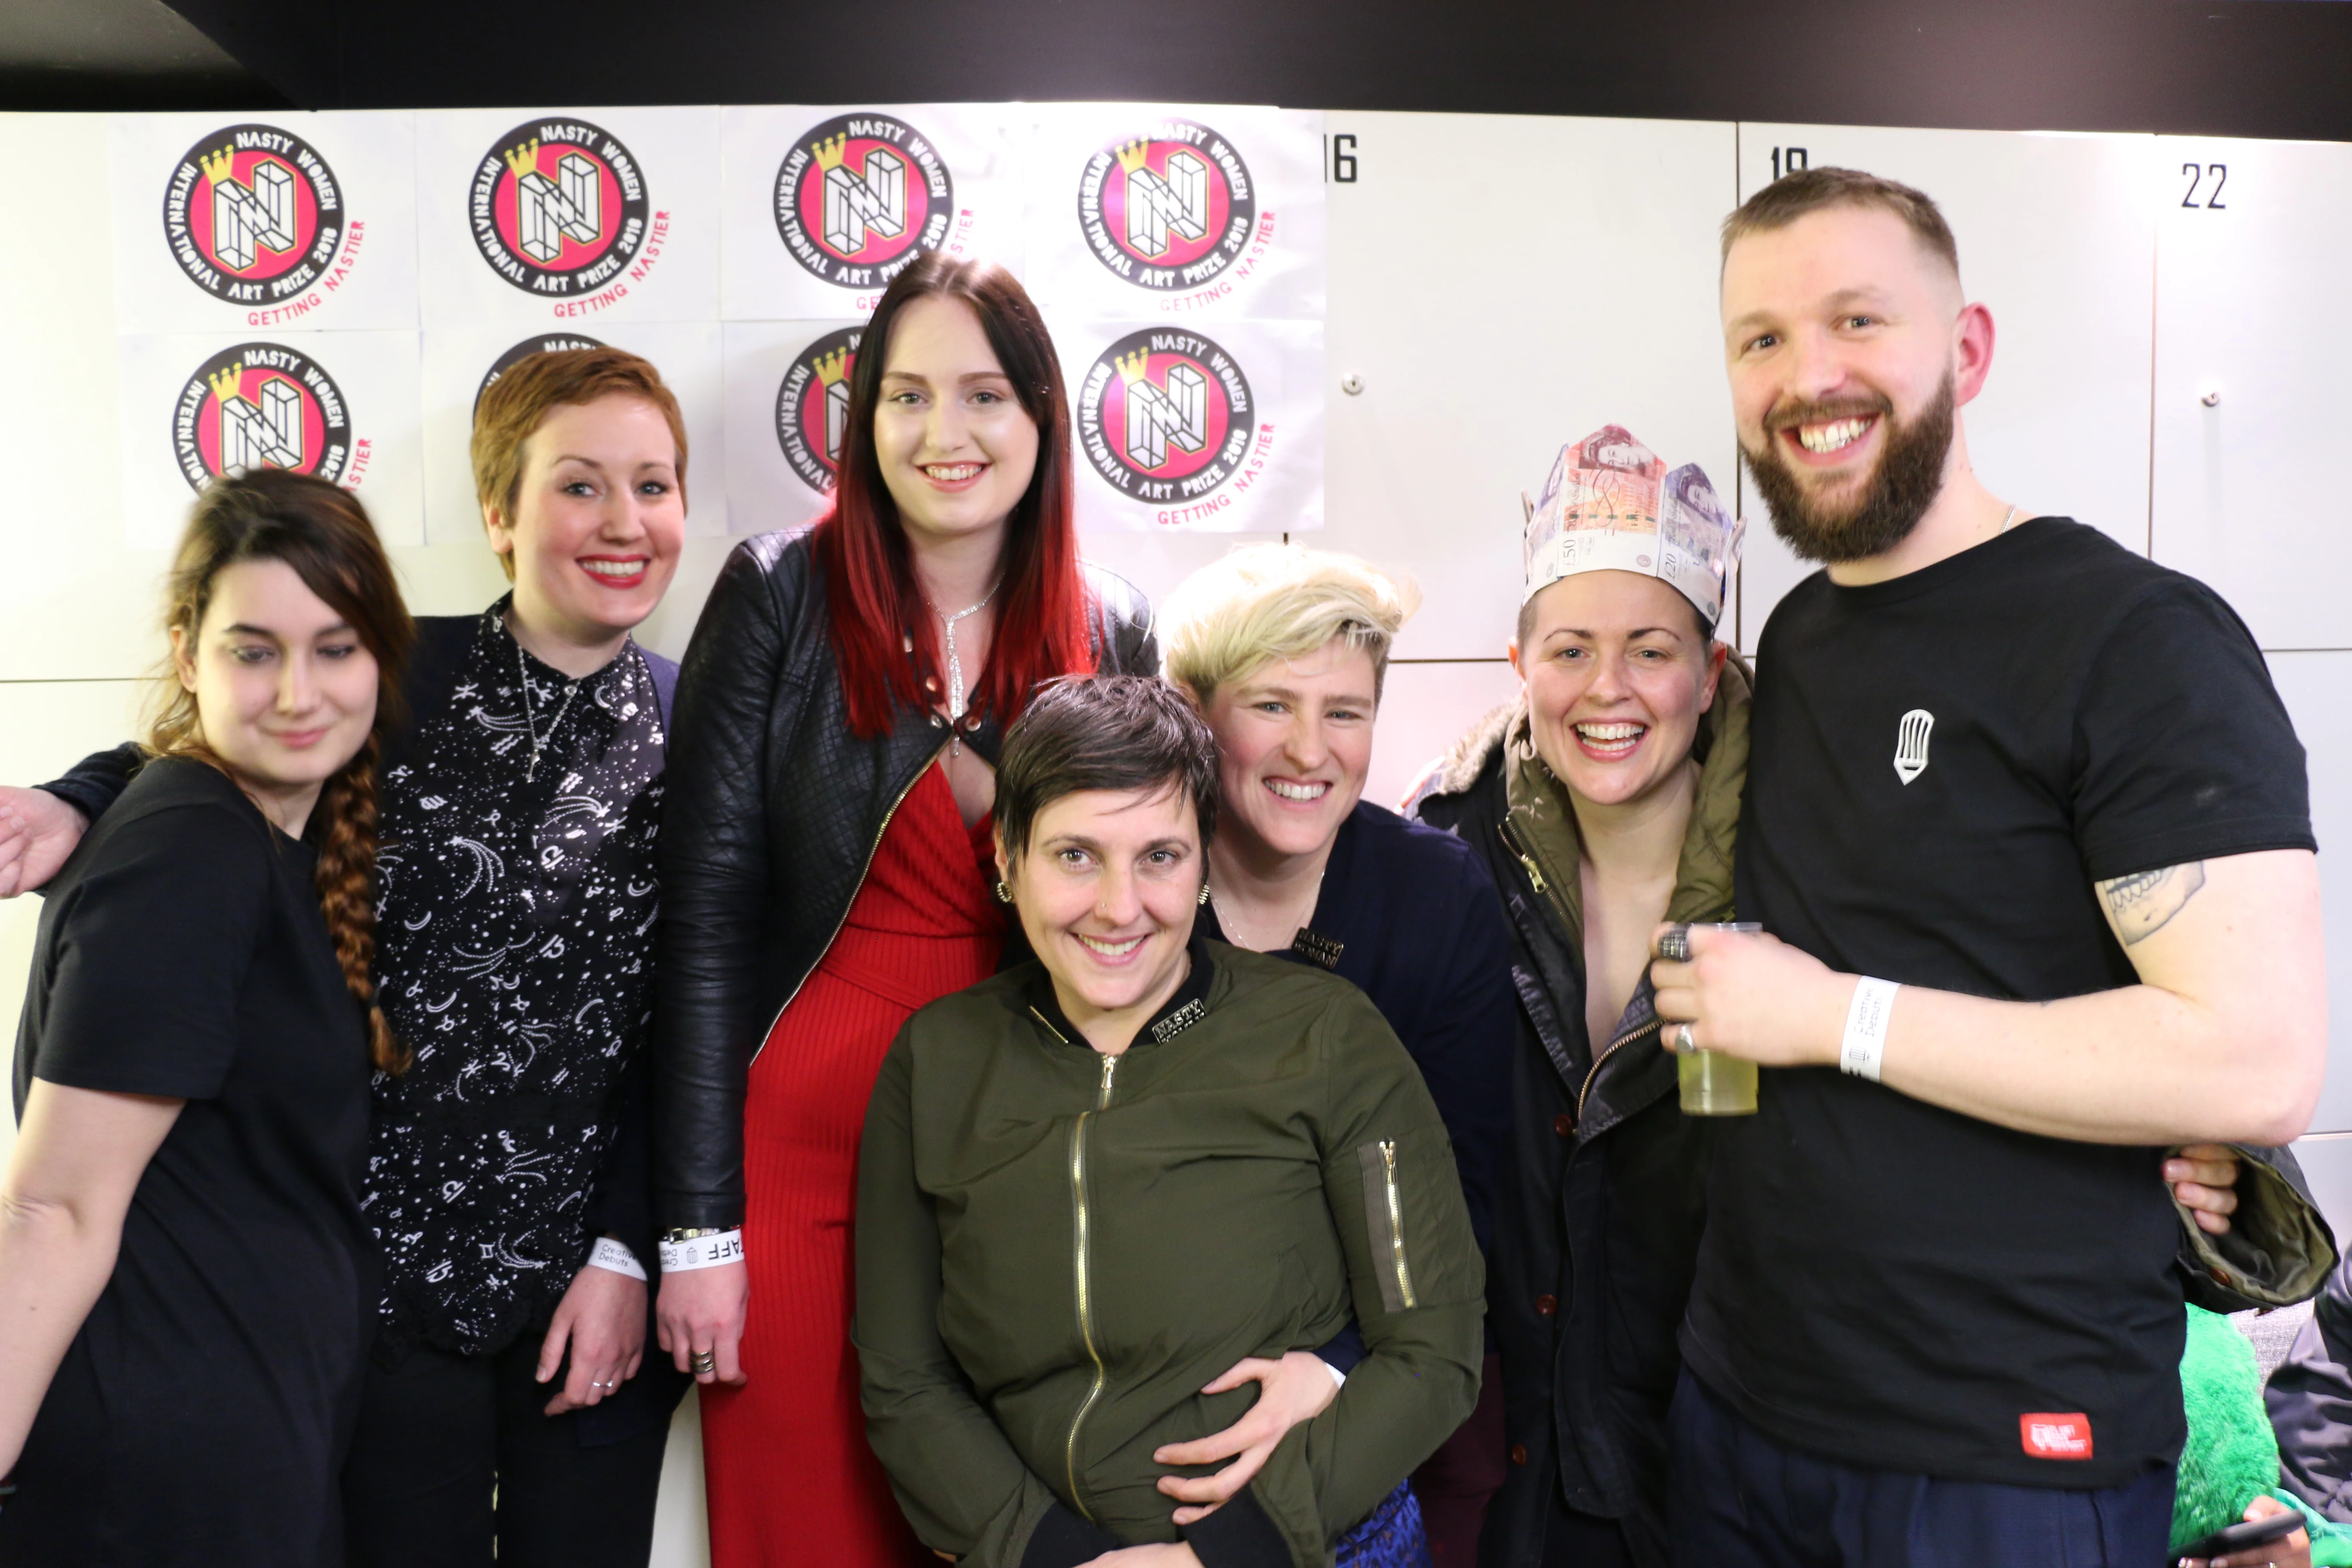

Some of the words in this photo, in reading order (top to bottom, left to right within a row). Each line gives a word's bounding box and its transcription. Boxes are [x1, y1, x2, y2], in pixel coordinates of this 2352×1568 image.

[236, 132, 294, 153] NASTY
[297, 149, 337, 211] WOMEN
[540, 125, 598, 146] NASTY
[602, 141, 642, 202] WOMEN
[848, 121, 906, 141] NASTY
[909, 138, 947, 198] WOMEN
[1151, 123, 1207, 146] NASTY
[1210, 140, 1248, 201] WOMEN
[2181, 163, 2227, 210] 22
[169, 162, 220, 290] INTERNATIONAL
[227, 282, 263, 300] ART
[272, 263, 316, 298] PRIZE
[313, 227, 338, 264] 2018
[474, 156, 525, 282] INTERNATIONAL
[533, 275, 569, 291] ART
[578, 254, 621, 289] PRIZE
[619, 218, 643, 254] 2018
[778, 148, 828, 275] INTERNATIONAL
[836, 268, 872, 285] ART
[922, 214, 947, 249] 2018
[950, 208, 974, 254] STIER
[1082, 151, 1133, 276] INTERNATIONAL
[1139, 270, 1175, 287] ART
[1183, 251, 1227, 285] PRIZE
[1225, 217, 1248, 253] 2018
[248, 292, 322, 326] GETTING
[325, 220, 365, 292] NASTIER
[554, 283, 628, 318] GETTING
[630, 211, 670, 282] NASTIER
[1161, 281, 1233, 312] GETTING
[1236, 211, 1276, 280] NASTIER
[244, 349, 302, 371] NASTY
[304, 367, 345, 429] WOMEN
[1151, 334, 1207, 356] NASTY
[1210, 352, 1248, 413] WOMEN
[178, 380, 213, 490] INTERNATION
[1082, 362, 1132, 489] INTERNATIONAL
[1139, 482, 1173, 500] ART
[1182, 465, 1225, 497] PRIZE
[1223, 429, 1248, 466] 2018
[1158, 493, 1231, 525] GETTING
[1234, 423, 1274, 493] NASTIER
[1562, 539, 1576, 567] £50
[1665, 553, 1677, 580] £20
[1155, 1000, 1201, 1039] NASTY
[599, 1252, 628, 1267] Debuts
